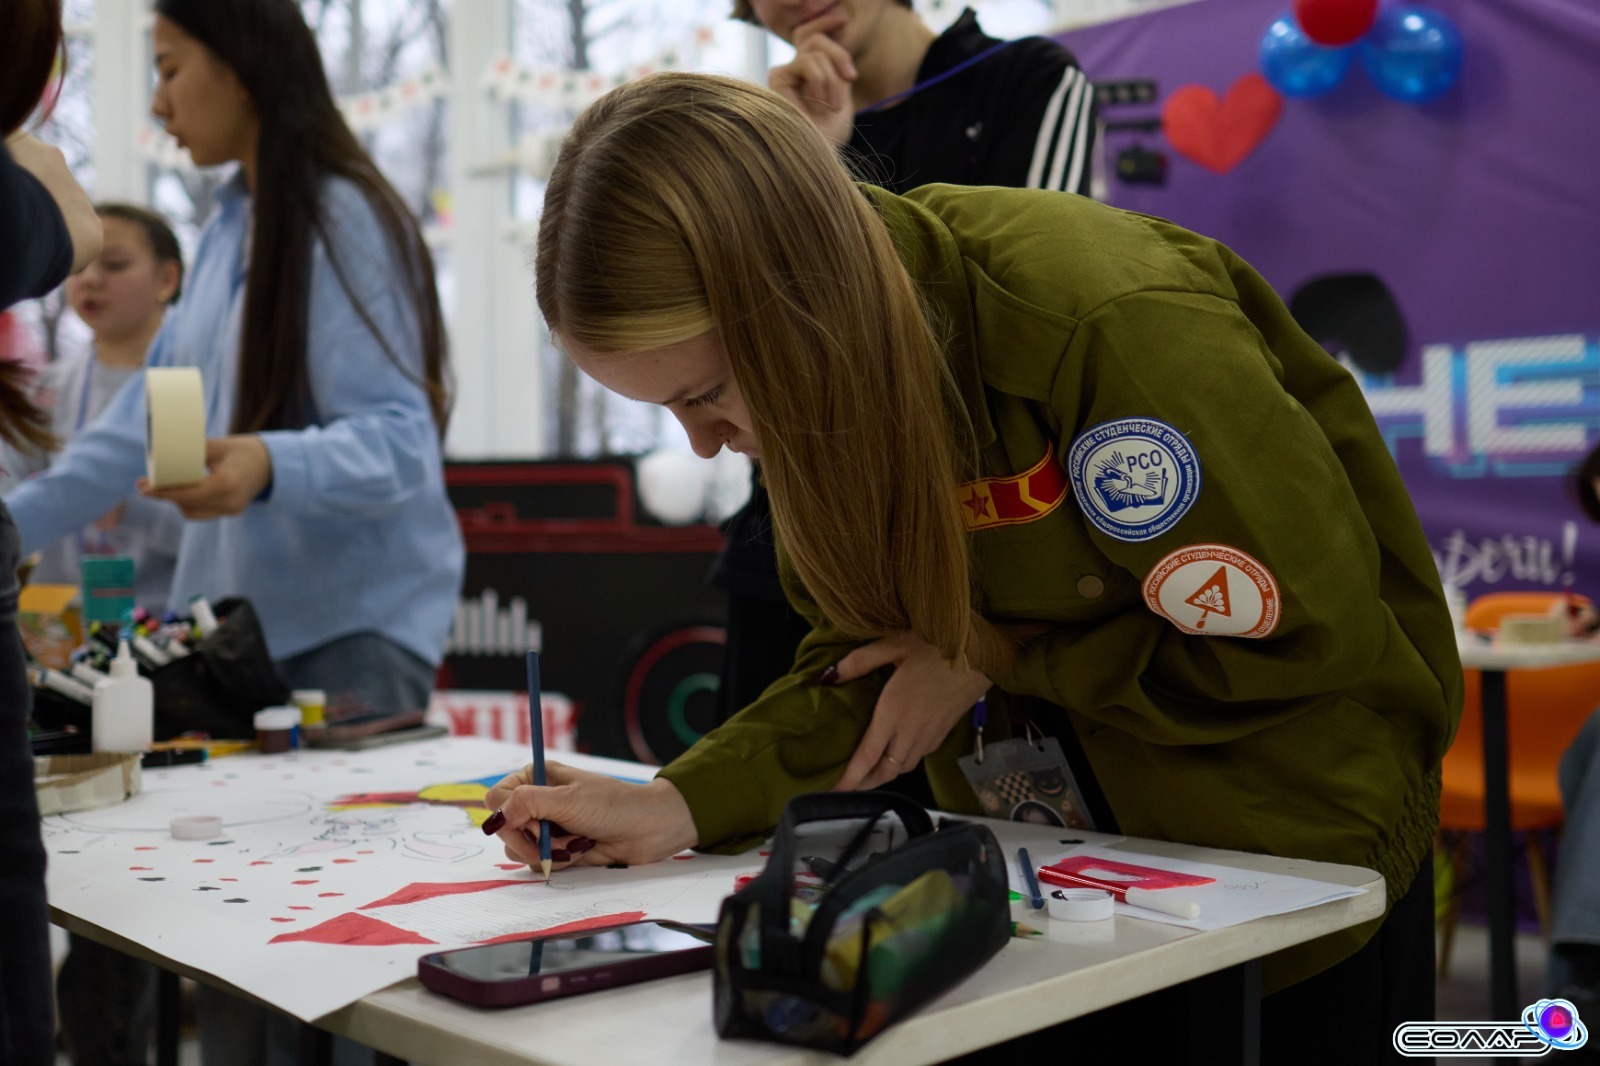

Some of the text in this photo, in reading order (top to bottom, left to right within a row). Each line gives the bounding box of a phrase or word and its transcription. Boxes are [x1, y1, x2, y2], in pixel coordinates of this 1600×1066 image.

[1073, 423, 1191, 479] РОССИЙСКИЕ СТУДЕНЧЕСКИЕ ОТРЯДЫ
[1126, 449, 1162, 472] РСО
[1149, 551, 1270, 594] РОССИЙСКИЕ СТУДЕНЧЕСКИЕ ОТРЯДЫ
